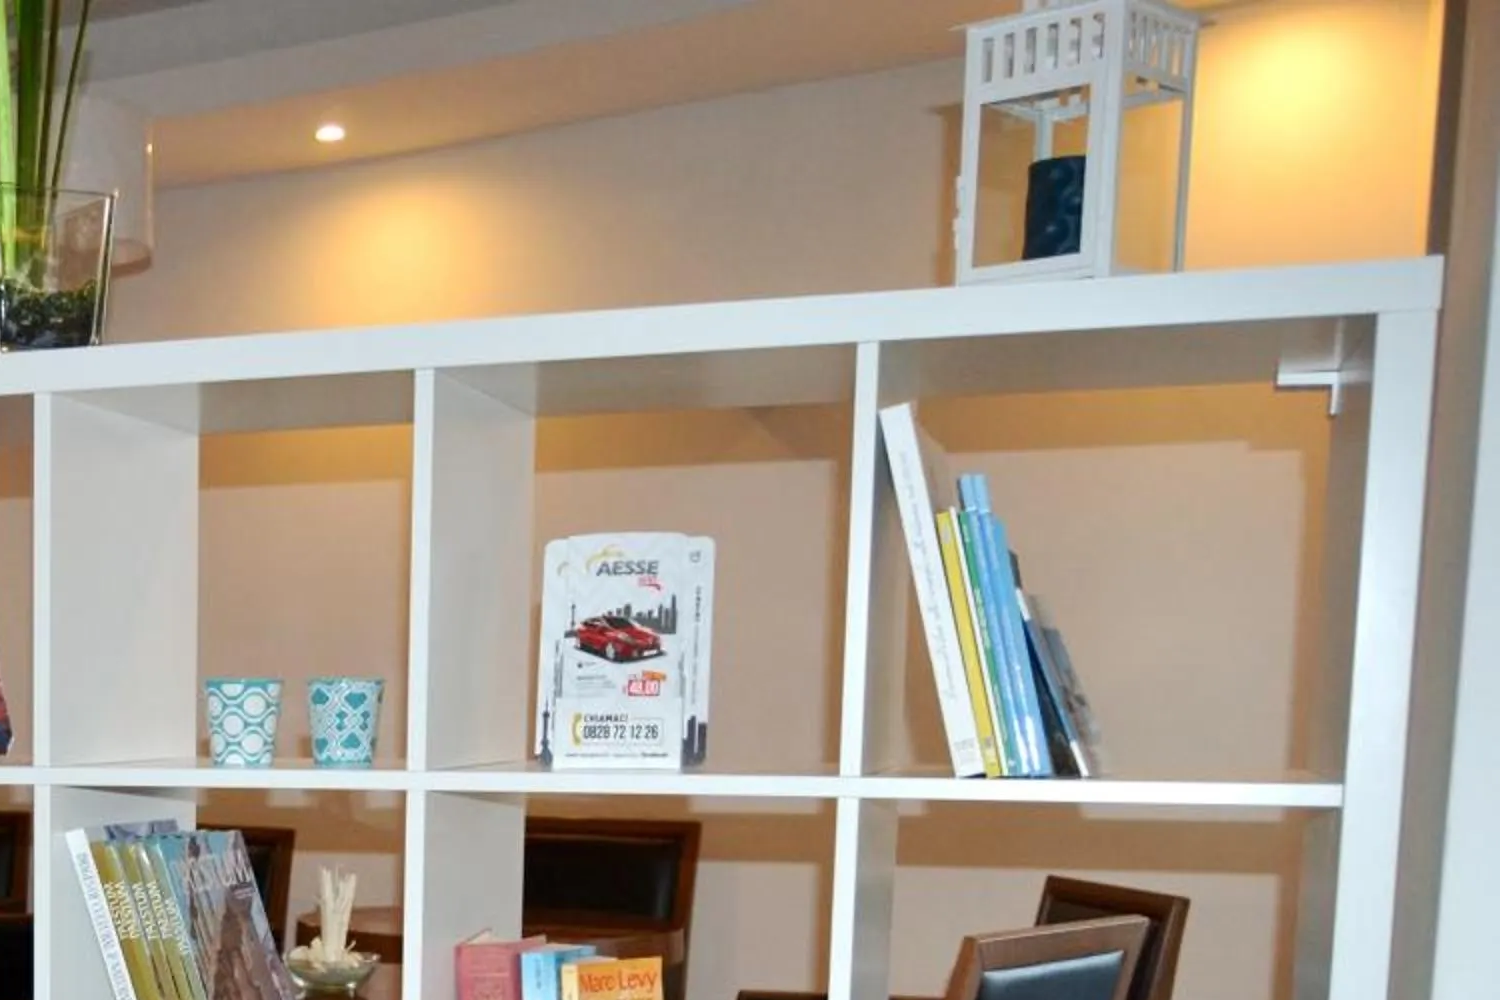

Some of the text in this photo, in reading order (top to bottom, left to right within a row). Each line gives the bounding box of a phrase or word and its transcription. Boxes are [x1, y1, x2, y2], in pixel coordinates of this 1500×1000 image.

[597, 561, 659, 576] AESSE
[583, 724, 659, 739] 0828 72 12 26
[580, 968, 658, 993] Marc Levy
